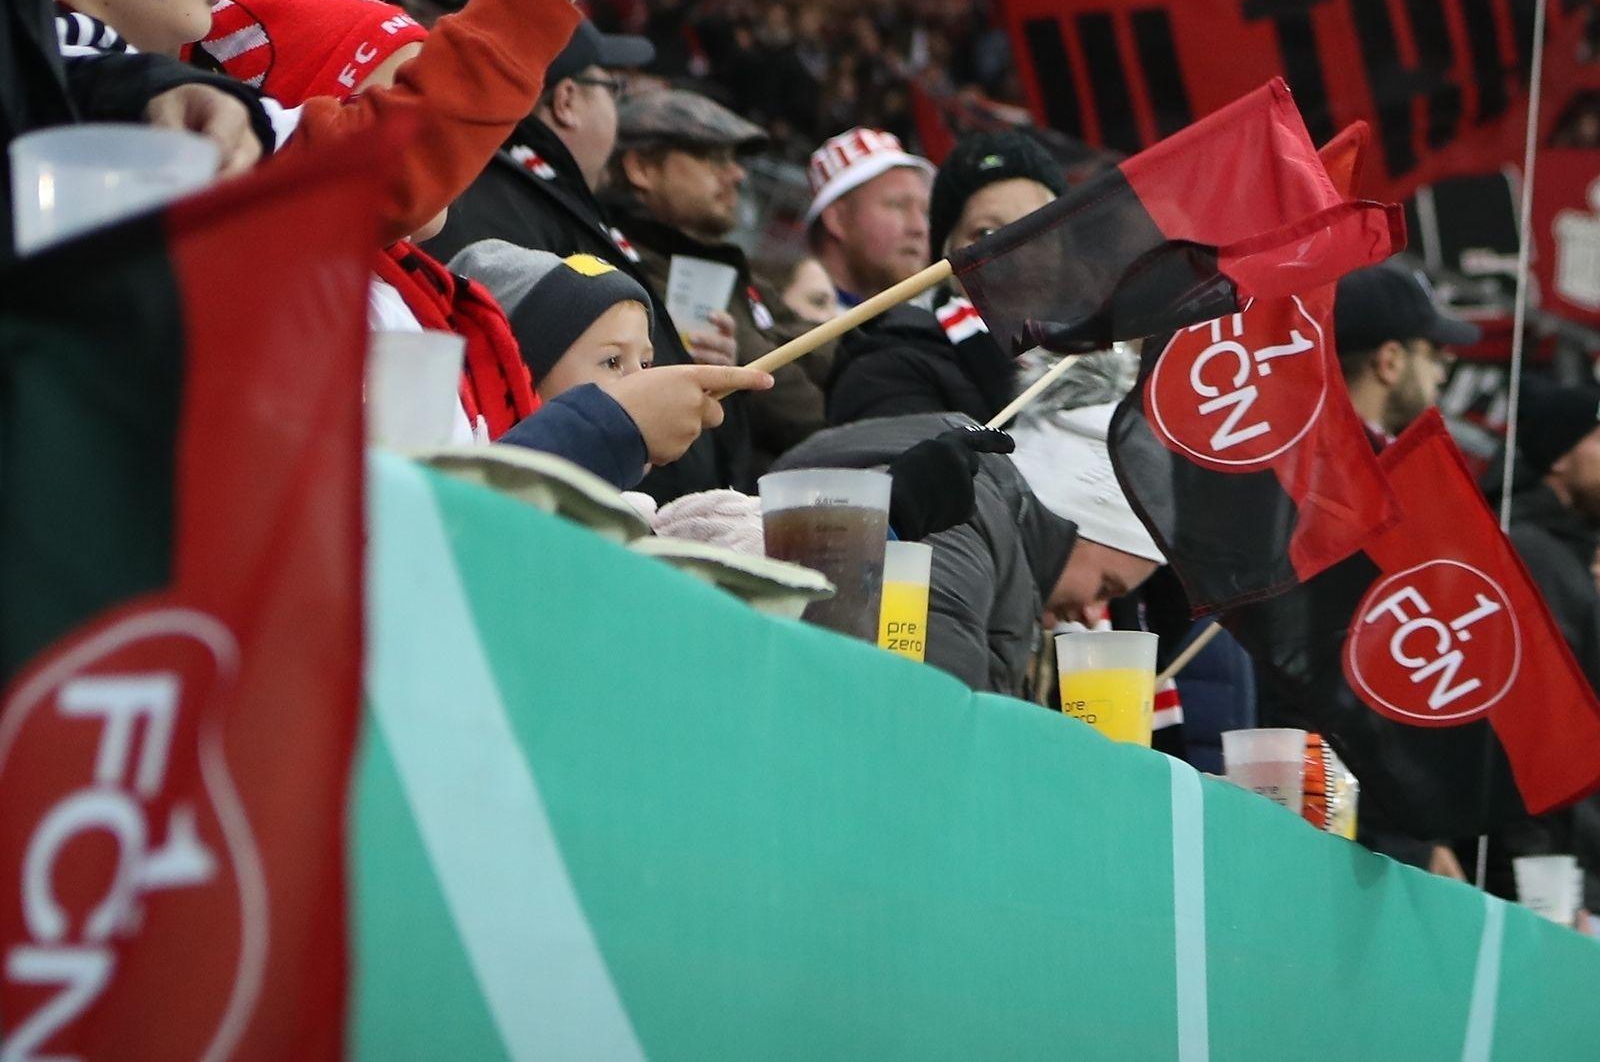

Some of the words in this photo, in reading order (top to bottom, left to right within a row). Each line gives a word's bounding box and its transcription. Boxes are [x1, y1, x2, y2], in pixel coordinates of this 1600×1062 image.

[1253, 329, 1315, 378] 1.
[887, 620, 917, 636] pre
[1449, 593, 1501, 642] 1.
[886, 637, 923, 653] zero
[1364, 585, 1482, 710] FCN
